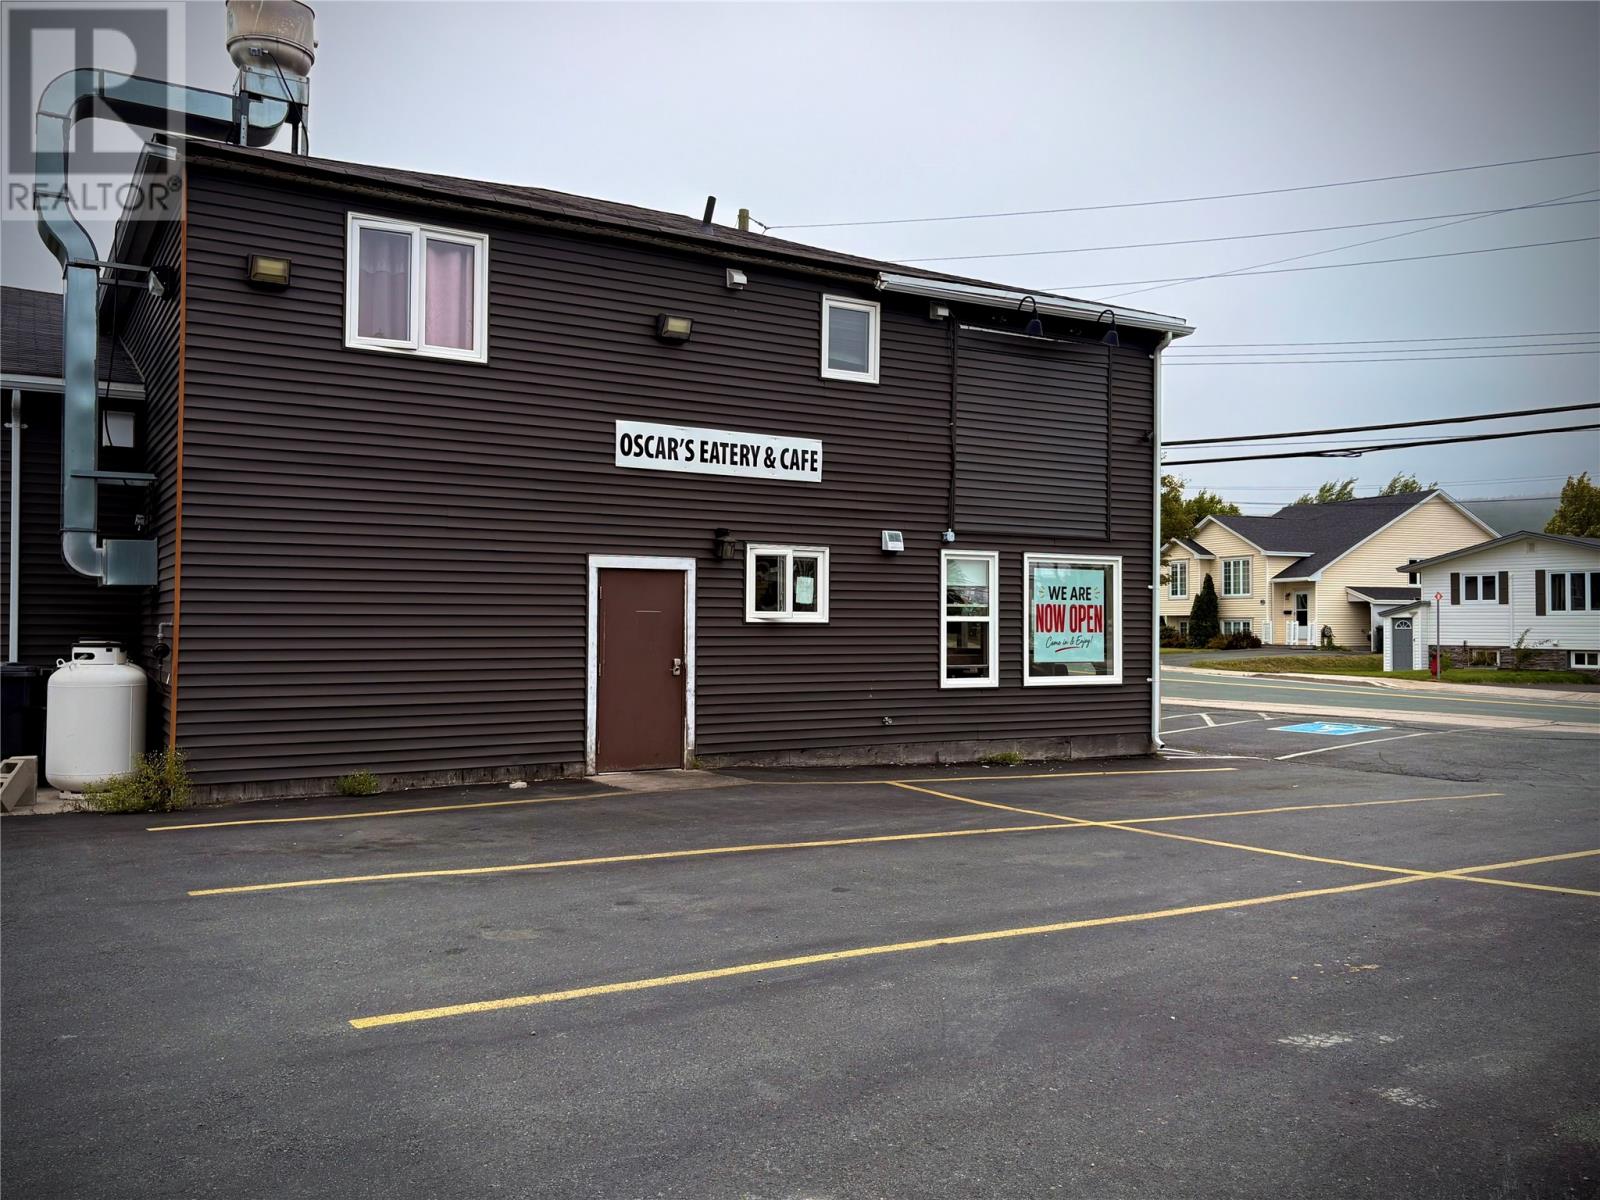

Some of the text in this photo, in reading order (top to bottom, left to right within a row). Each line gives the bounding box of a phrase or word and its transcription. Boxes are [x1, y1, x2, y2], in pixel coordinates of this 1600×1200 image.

[620, 433, 819, 472] OSCAR'S EATERY & CAFE
[1048, 586, 1092, 601] WE ARE
[1035, 603, 1103, 633] NOW OPEN
